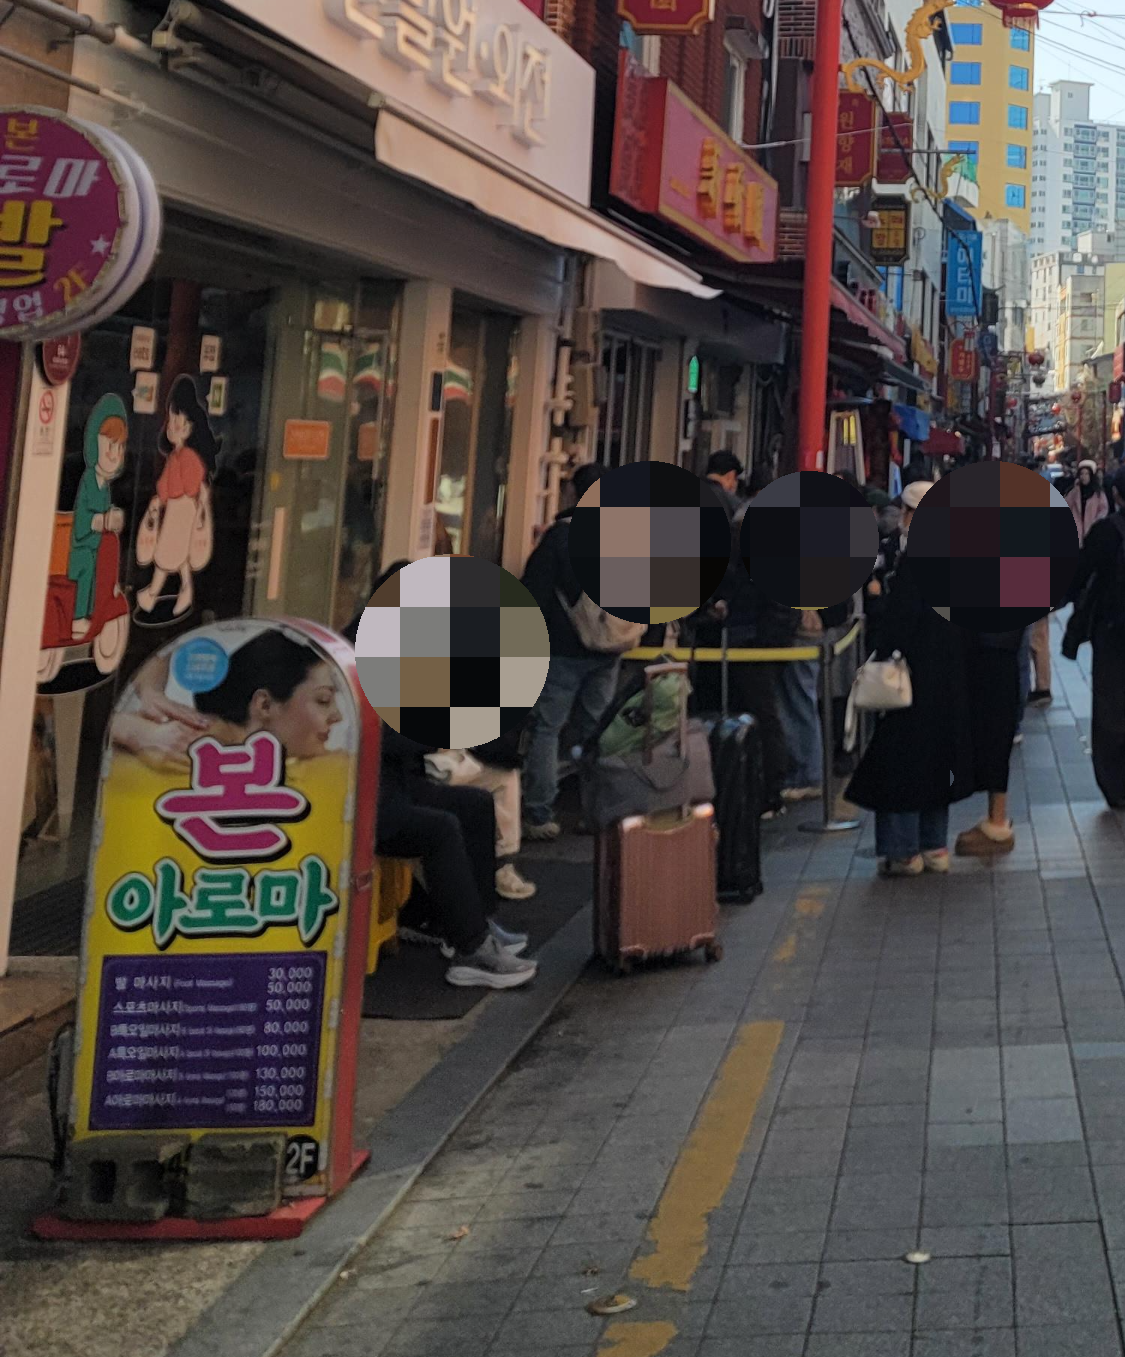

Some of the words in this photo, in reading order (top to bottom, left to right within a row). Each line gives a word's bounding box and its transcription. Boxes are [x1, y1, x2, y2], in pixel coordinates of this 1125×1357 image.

[5, 118, 39, 151] 본
[155, 730, 309, 862] 본
[106, 854, 339, 950] 아로마
[285, 1143, 316, 1175] 2F
